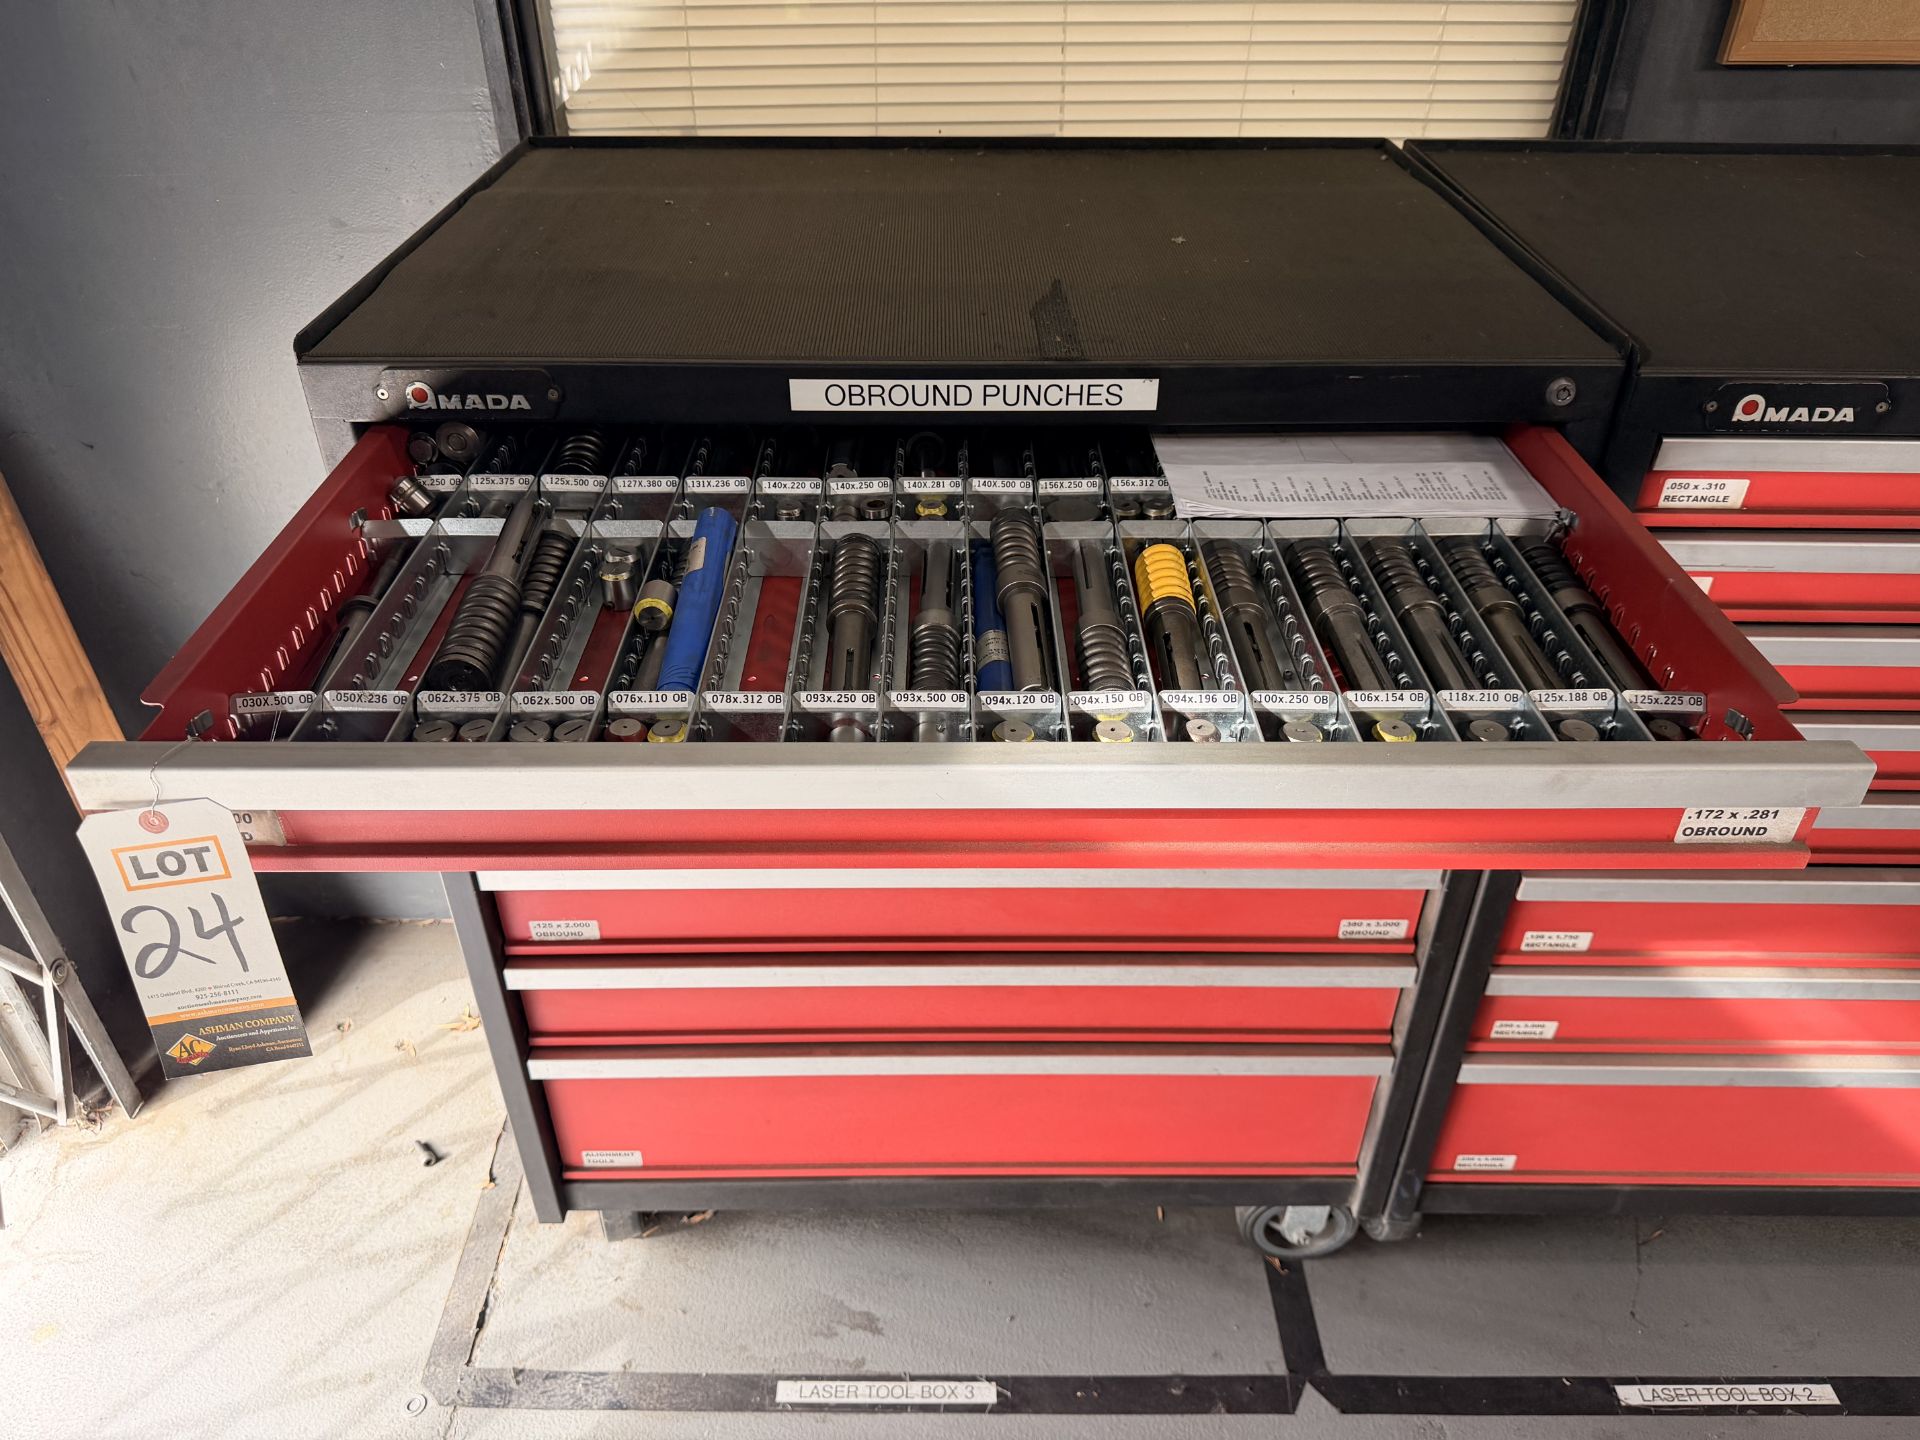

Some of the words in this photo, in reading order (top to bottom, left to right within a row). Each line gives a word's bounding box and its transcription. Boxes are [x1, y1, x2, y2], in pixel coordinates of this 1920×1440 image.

[405, 381, 532, 411] AMADA
[824, 383, 973, 407] OBROUND
[982, 383, 1124, 407] PUNCHES
[1731, 394, 1855, 422] AMADA
[471, 477, 515, 486] .125x.375
[518, 477, 530, 486] OB
[546, 477, 590, 487] .125x.500
[593, 479, 605, 488] OB
[619, 480, 662, 488] .127X.380
[665, 480, 678, 488] OB
[688, 480, 731, 488] .131X.236
[734, 479, 746, 487] OB
[763, 481, 806, 489] .140x.220
[809, 481, 821, 489] OB
[832, 481, 874, 490] .140x.250
[877, 480, 889, 489] OB
[904, 481, 945, 489] .140X.281
[949, 480, 961, 488] OB
[973, 480, 1016, 489] .140X.500
[1019, 481, 1031, 489] OB
[1040, 481, 1083, 490] .156X.250
[1086, 480, 1098, 488] OB
[1112, 479, 1154, 487] .156x.312
[1157, 479, 1169, 487] OB
[1666, 482, 1690, 490] .050
[1702, 482, 1726, 490] .310
[1662, 495, 1730, 503] RECTANGLE
[238, 695, 294, 708] .030X.500
[299, 694, 313, 704] OB
[331, 692, 388, 704] .050X.236
[393, 695, 408, 705] OB
[423, 691, 480, 703] .062x.375
[484, 691, 501, 702] OB
[518, 695, 575, 706] .062x.500
[580, 695, 595, 705] OB
[611, 693, 669, 704] .076x.110
[672, 692, 688, 703] OB
[708, 694, 764, 704] .078x.312
[767, 694, 782, 704] OB
[802, 693, 857, 703] .093x.250
[860, 693, 876, 704] OB
[892, 692, 947, 703] .093x.500
[951, 692, 966, 702] OB
[981, 693, 1036, 705] .094x.120
[1039, 693, 1055, 703] OB
[1070, 693, 1124, 706] .094x.150
[1129, 692, 1144, 702] OB
[1163, 694, 1218, 704] .094x.196
[1222, 693, 1237, 703] OB
[1253, 694, 1309, 704] .100x.250
[1313, 694, 1329, 705] OB
[1409, 692, 1424, 702] OB
[1443, 692, 1499, 702] .118x.210
[1504, 693, 1519, 703] OB
[1533, 692, 1588, 703] .125x.188
[1593, 692, 1608, 701] OB
[1629, 694, 1684, 705] .125x.225
[1688, 696, 1703, 706] OB
[1687, 809, 1725, 820] .172
[1727, 811, 1739, 820] x
[1743, 809, 1780, 820] .281
[1682, 826, 1768, 837] OBROUND
[128, 845, 211, 881] LOT
[120, 892, 250, 979] 24
[195, 988, 239, 1000] 925-256-8111
[199, 1021, 244, 1036] ASHMAN
[244, 1014, 296, 1029] COMPANY
[799, 1384, 859, 1399] LASER
[864, 1384, 917, 1399] TOOL
[920, 1384, 959, 1399] BOX
[964, 1384, 975, 1400] 3
[1637, 1387, 1701, 1402] LASER
[1702, 1387, 1759, 1402] TOOL
[1758, 1387, 1800, 1402] BOX
[1802, 1387, 1818, 1401] 2
